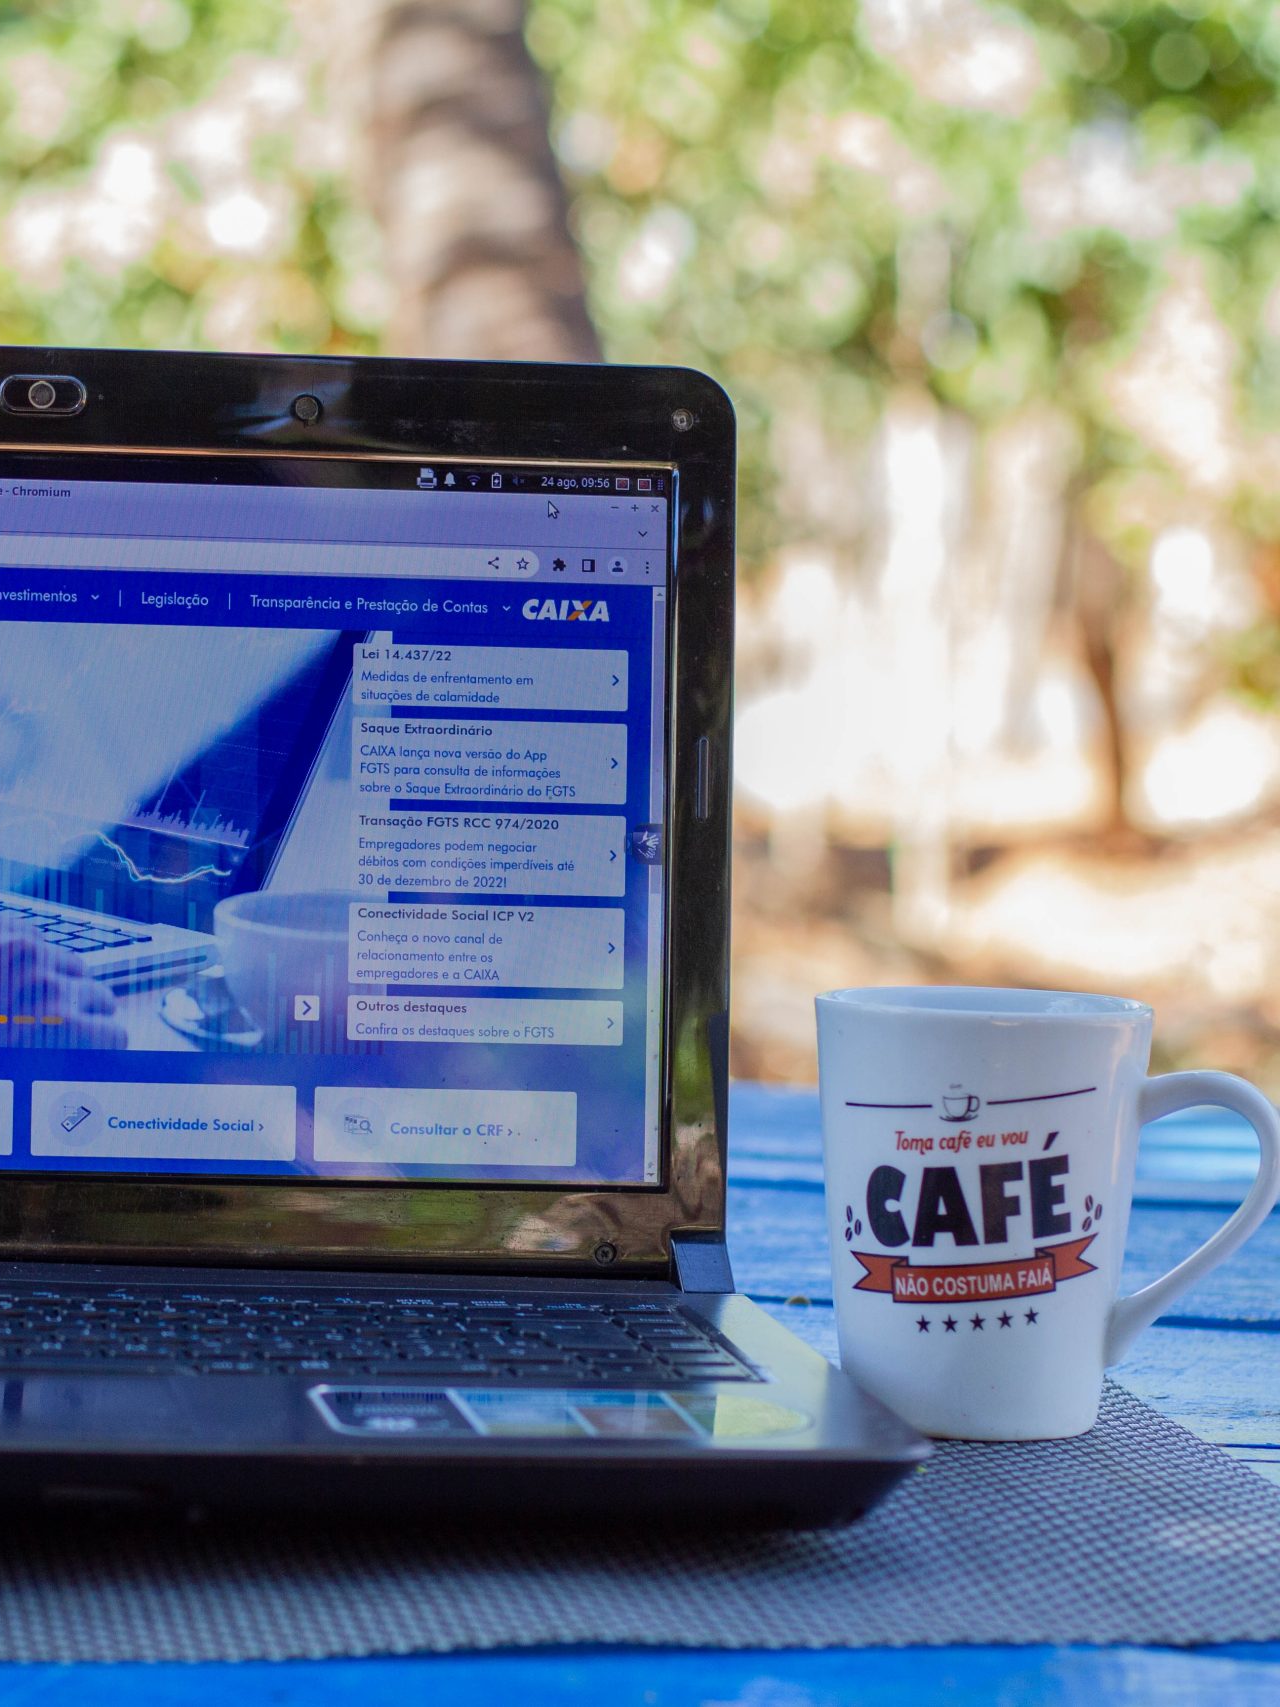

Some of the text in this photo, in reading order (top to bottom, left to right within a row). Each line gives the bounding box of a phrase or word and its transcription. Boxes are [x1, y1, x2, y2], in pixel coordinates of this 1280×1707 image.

[541, 477, 609, 489] 24 ago, 09:56
[12, 486, 71, 497] Chromium
[141, 592, 208, 609] Legislação
[250, 594, 488, 616] Transparência e Prestação de Contas
[522, 598, 610, 622] CAIXA
[362, 649, 451, 661] Lei 14.437/22
[361, 671, 533, 686] Medidas de enfrentamento em
[361, 690, 500, 703] situações de calamidade
[361, 723, 493, 736] Saque Extraordinário
[361, 745, 547, 763] CAIXA lança nova versão do App
[361, 763, 560, 780] FGTS para consulta de informações
[360, 782, 575, 797] sobre o Saque Extraordinário do FGTS
[359, 815, 558, 831] Transação FGTS RCC 974/2020
[359, 838, 536, 854] Empregadores podem negociar
[359, 856, 574, 873] débitos com condições imperdíveis até
[358, 874, 373, 885] 30
[377, 875, 391, 886] de
[395, 875, 451, 887] dezembro
[455, 876, 469, 887] de
[358, 908, 534, 922] Conectividade Social ICP V2
[358, 931, 408, 943] Conheça
[423, 935, 450, 943] novo
[454, 933, 484, 944] canal
[489, 933, 502, 944] de
[357, 950, 493, 963] relacionamento entre os
[356, 968, 438, 982] empregadores
[453, 972, 460, 980] a
[464, 969, 499, 980] CAIXA
[357, 1000, 467, 1015] Outros destaques
[356, 1023, 554, 1039] Confira os destaques sobre o FGTS
[108, 1116, 254, 1133] Conectividade Social
[390, 1121, 503, 1137] Consultar o CRF
[939, 1131, 972, 1152] café
[977, 1135, 995, 1148] eu
[1001, 1130, 1028, 1145] vou
[866, 1131, 1071, 1248] CAFÉ
[895, 1263, 1052, 1296] NÃO COSTUMA FAIÁ
